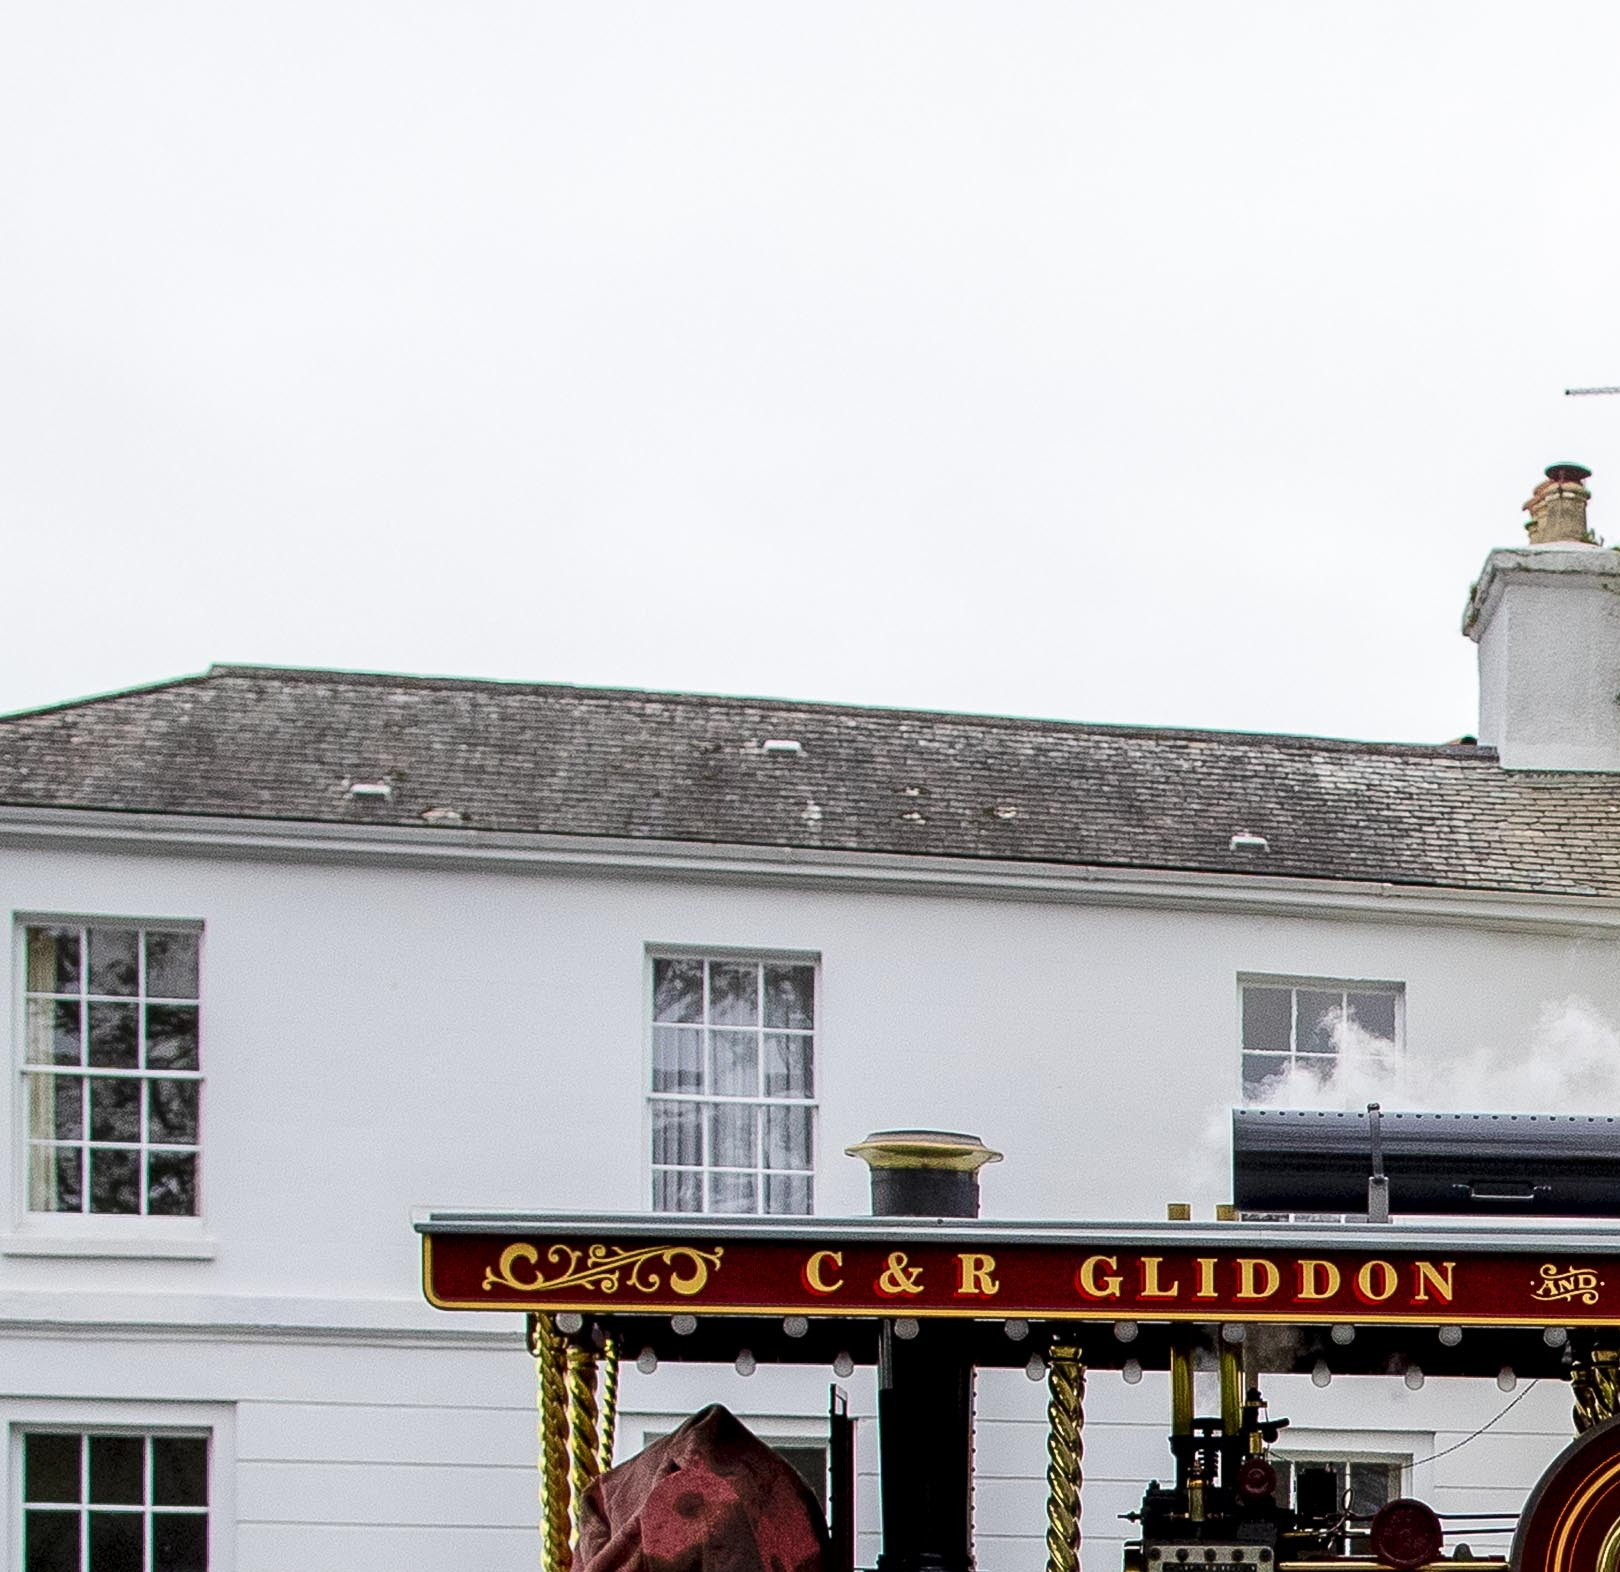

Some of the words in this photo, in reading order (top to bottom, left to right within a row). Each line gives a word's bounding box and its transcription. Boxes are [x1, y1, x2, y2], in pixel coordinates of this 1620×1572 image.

[805, 1251, 844, 1293] C
[879, 1253, 924, 1295] &
[956, 1253, 1000, 1295] R
[1080, 1256, 1456, 1300] GLIDDON
[1534, 1270, 1598, 1300] AND
